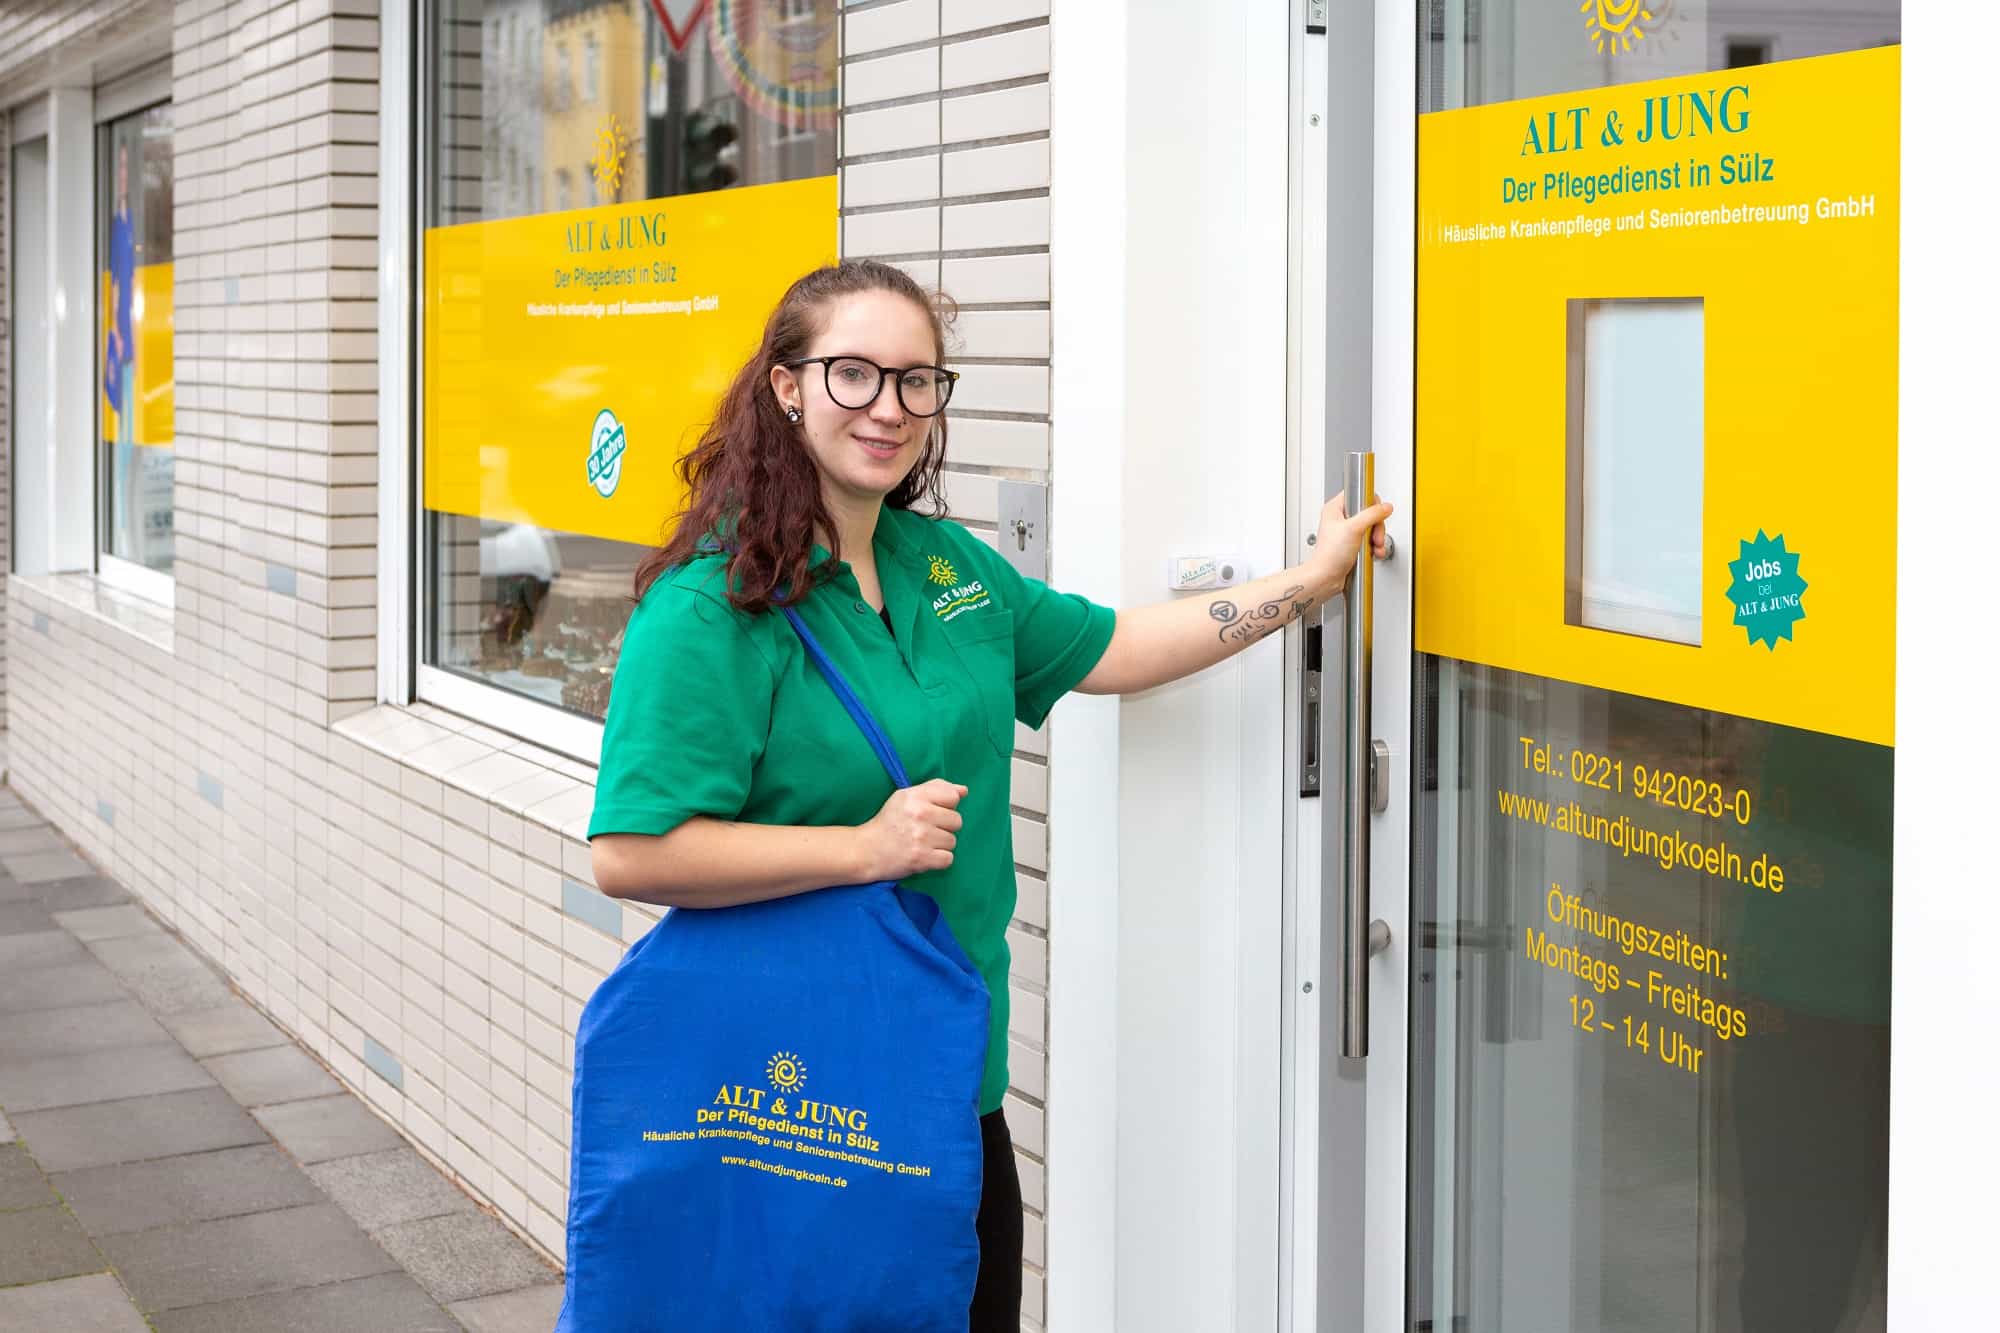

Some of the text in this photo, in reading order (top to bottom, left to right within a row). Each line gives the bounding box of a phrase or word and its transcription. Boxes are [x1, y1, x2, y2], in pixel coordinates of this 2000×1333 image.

[1521, 84, 1752, 156] ALT & JUNG
[1503, 152, 1774, 204] Der Pflegedienst in Sülz
[600, 224, 611, 251] &
[616, 213, 667, 249] JUNG
[1444, 194, 1875, 243] Häusliche Krankenpflege und Seniorenbetreuung GmbH
[555, 261, 677, 292] Der Pflegedienst in Sülz
[589, 433, 624, 478] 30 Jahre
[1745, 558, 1782, 582] Jobs
[1758, 583, 1773, 596] bei
[933, 592, 951, 611] ALT
[1739, 593, 1799, 616] ALT & JUNG
[1519, 737, 1751, 825] Tel.: 0221 942023-0
[1498, 790, 1785, 893] www.altundjungkoeln.de
[1547, 882, 1728, 980] Öffnungszeiten:
[1526, 927, 1620, 993] Montags
[1648, 970, 1747, 1040] Freitags
[1569, 994, 1594, 1033] 12
[1623, 1015, 1650, 1054] 14
[1660, 1026, 1703, 1073] Uhr
[697, 1108, 880, 1152] Der Pflegedienst in Sülz
[713, 1084, 868, 1131] ALT & JUNG
[643, 1128, 931, 1177] Häusliche Krankenpflege und Seniorenbetreuung GmbH
[721, 1154, 848, 1188] www.altundjungkoeln.de
